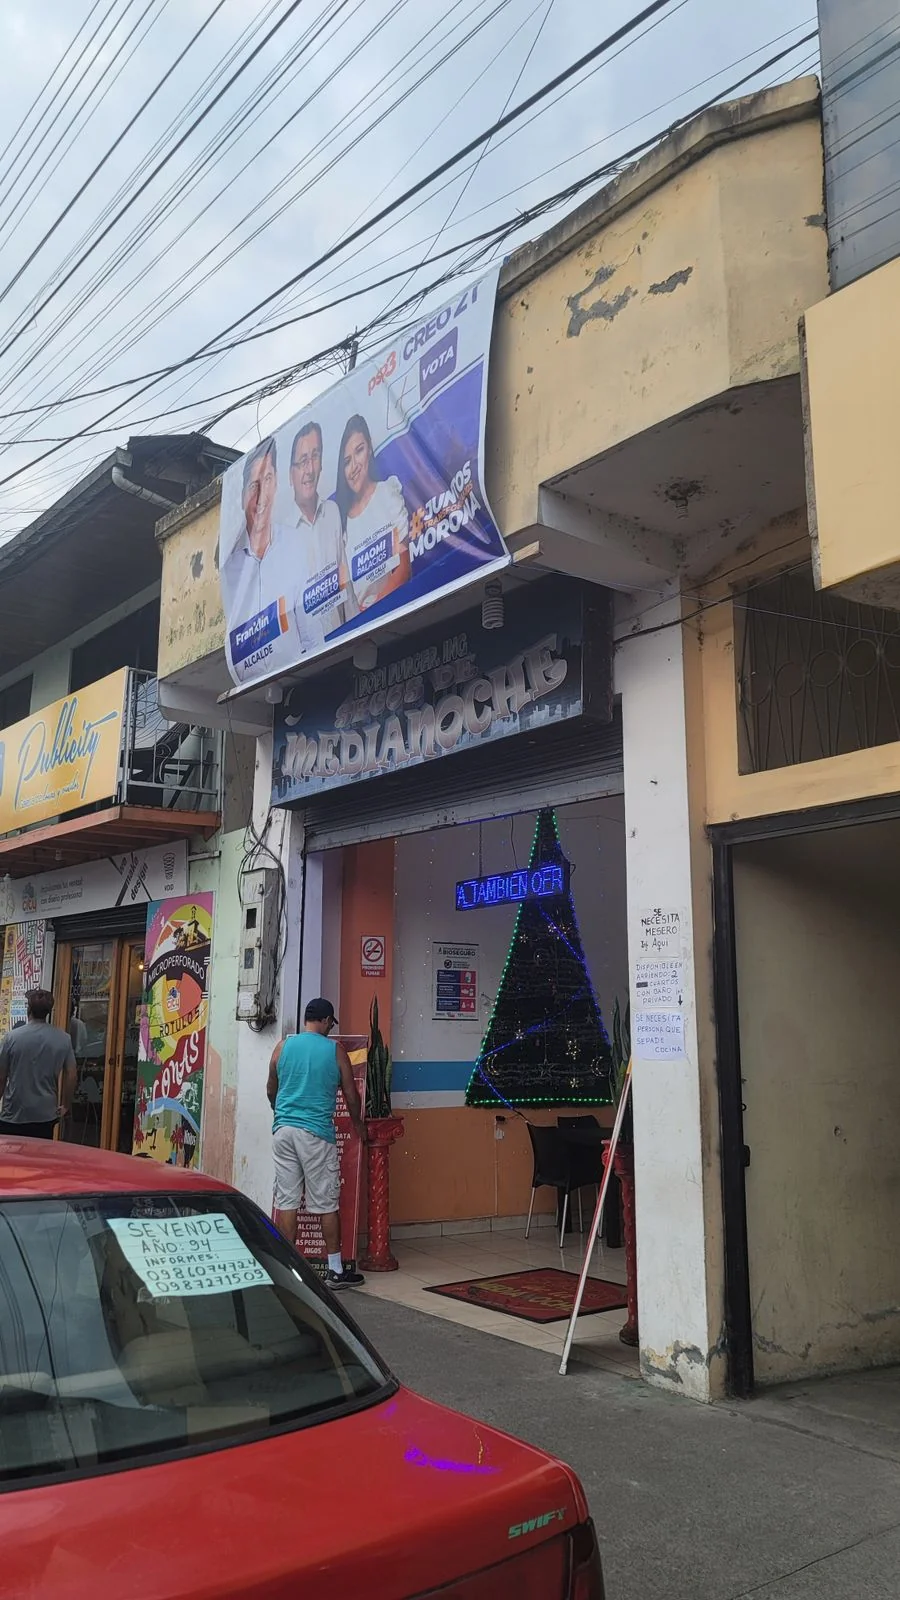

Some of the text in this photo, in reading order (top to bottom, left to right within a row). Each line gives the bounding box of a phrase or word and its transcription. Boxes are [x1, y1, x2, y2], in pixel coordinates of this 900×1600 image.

[403, 306, 451, 360] CREO
[422, 345, 454, 381] VOTA
[409, 490, 481, 563] MORONA
[357, 539, 386, 567] NAOMI
[357, 550, 387, 576] PALACIOS
[305, 573, 338, 602] MARCELO
[305, 582, 339, 610] JARAMILLO
[236, 615, 269, 646] Franklin
[244, 643, 274, 670] ALCALDE
[430, 652, 479, 691] DE
[281, 633, 568, 780] MEDIANOCHE
[14, 696, 119, 811] Publicity
[130, 863, 149, 901] design
[471, 874, 528, 903] TAMBIEN
[641, 913, 681, 926] NECESITA
[653, 908, 662, 917] SE
[645, 926, 678, 936] MESERO
[443, 949, 476, 957] BIOSEGURO
[148, 954, 205, 983] MICROPERFORADO
[671, 970, 679, 978] 2
[636, 988, 651, 997] CON
[649, 979, 679, 987] CUARTOS
[642, 995, 673, 1004] PRIVADO
[159, 1007, 200, 1037] ROTULOS
[635, 1014, 681, 1023] SE NECESITA
[665, 1026, 681, 1034] QUE
[150, 1030, 199, 1117] LONAS
[142, 1238, 212, 1254] AÑO: 94
[155, 1269, 265, 1293] 0987271509
[508, 1507, 567, 1539] SWIFT
